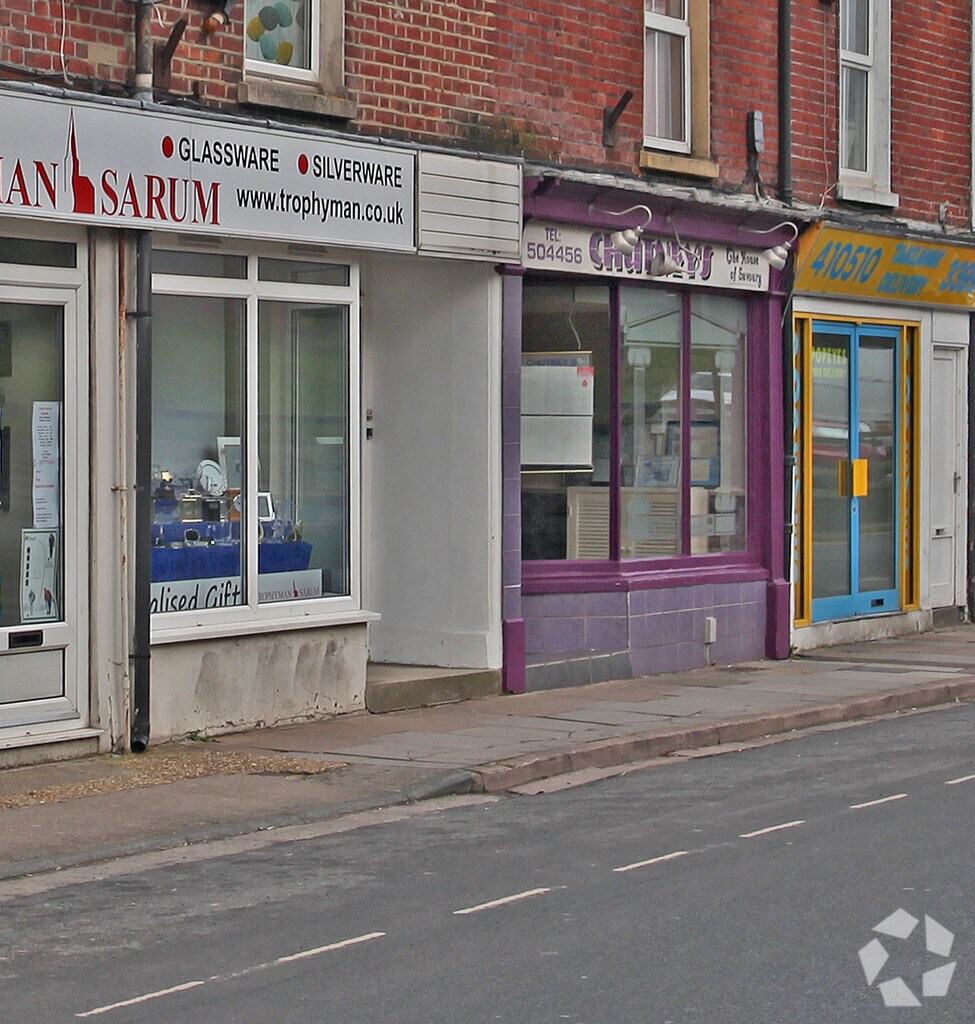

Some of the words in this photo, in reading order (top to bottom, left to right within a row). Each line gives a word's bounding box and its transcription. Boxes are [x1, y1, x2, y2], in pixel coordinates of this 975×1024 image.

[178, 137, 280, 172] GLASSWARE
[312, 155, 402, 188] SILVERWARE
[100, 170, 222, 226] SARUM
[236, 187, 404, 226] www.trophyman.co.uk
[545, 227, 562, 242] TEL:
[527, 242, 582, 264] 504456
[811, 240, 884, 284] 410510
[730, 266, 737, 282] of
[298, 587, 320, 598] SARUM
